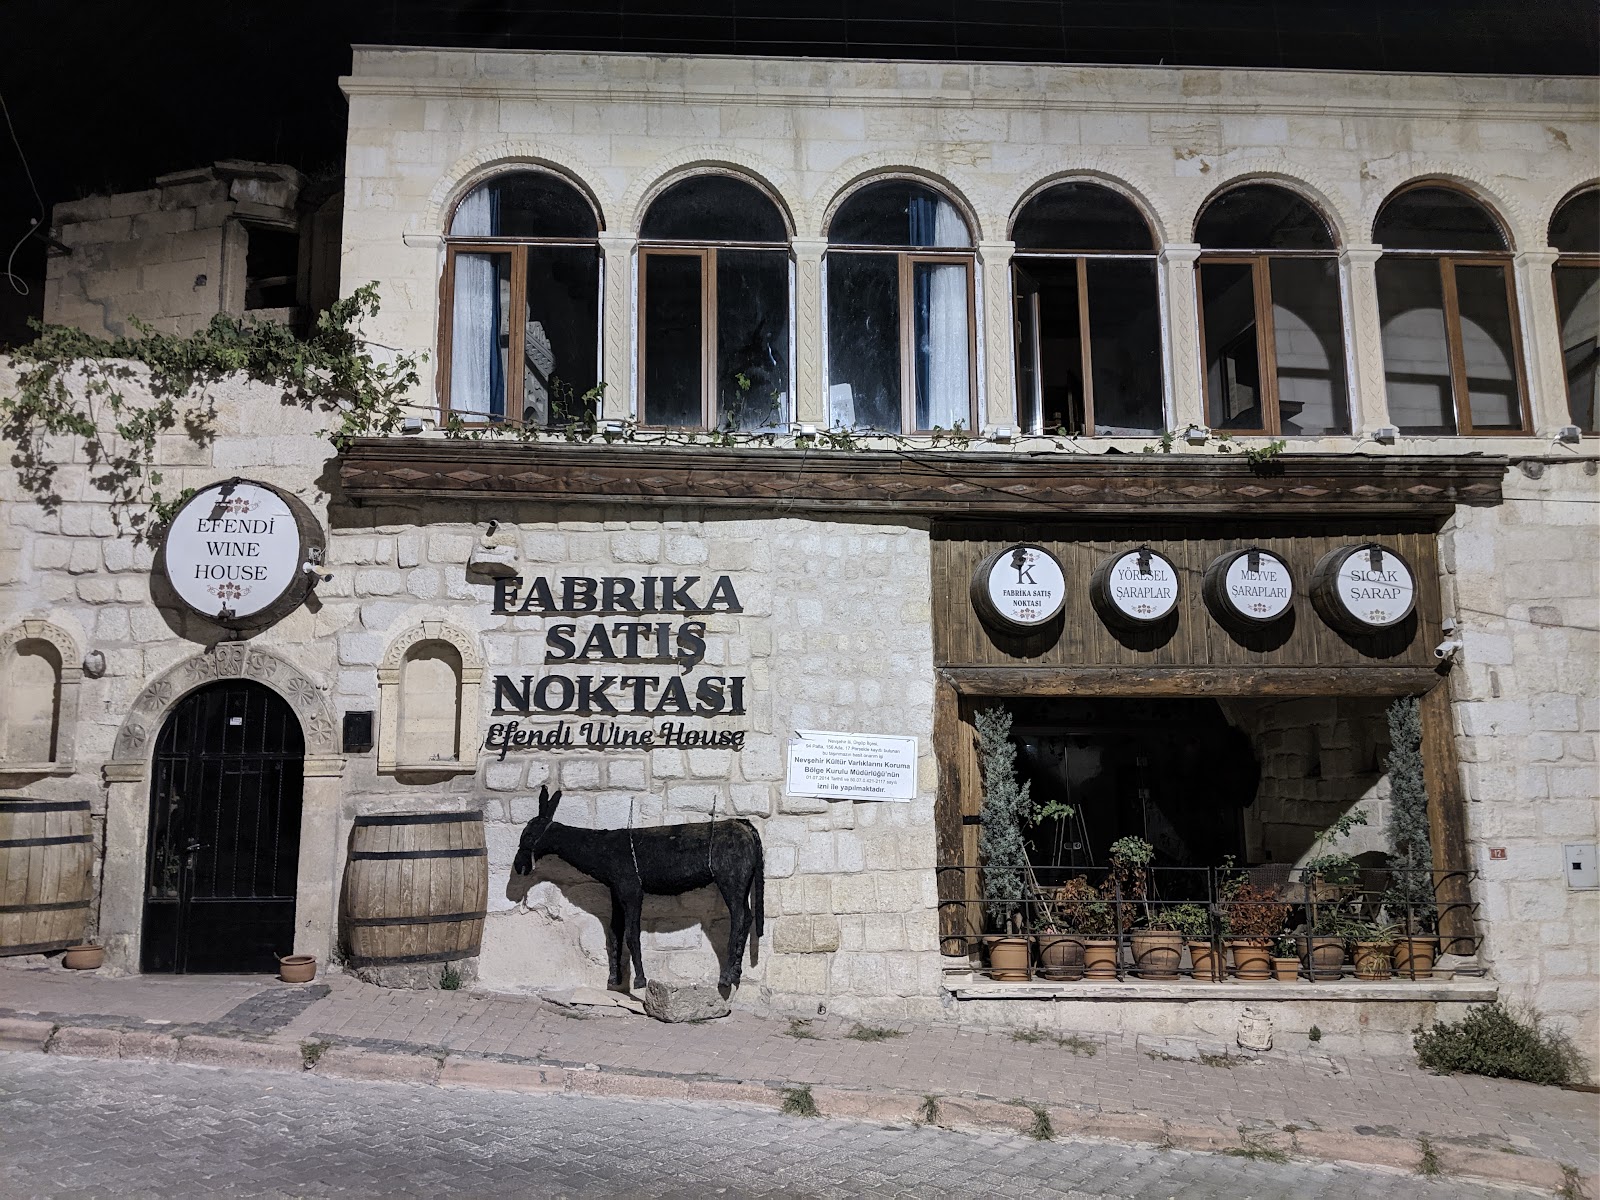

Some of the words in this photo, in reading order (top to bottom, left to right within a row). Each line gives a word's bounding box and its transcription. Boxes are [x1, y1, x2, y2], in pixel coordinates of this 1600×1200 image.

[196, 517, 275, 534] EFENDİ
[206, 541, 260, 557] WINE
[194, 564, 268, 581] HOUSE
[1016, 564, 1037, 585] K
[1241, 570, 1277, 582] MEYVE
[1351, 570, 1398, 582] SICAK
[491, 575, 744, 614] FABRIKA
[1003, 588, 1031, 597] FABRİKA
[1032, 590, 1051, 599] SATIŞ
[1116, 586, 1171, 600] ŞARAPLAR
[1231, 585, 1288, 598] ŞARAPLARI
[1350, 587, 1401, 601] ŞARAP
[545, 621, 706, 676] SATIŞ
[491, 675, 747, 715] NOKTASI
[485, 721, 573, 761] Efendi
[579, 722, 655, 747] Wine
[658, 722, 746, 748] House
[794, 756, 824, 764] Nevşehir
[848, 759, 883, 767] Varlıklarını
[884, 761, 911, 769] Koruma
[804, 766, 824, 775] Bölge
[825, 767, 848, 775] Kurulu
[840, 785, 886, 793] yapılmaktadır.
